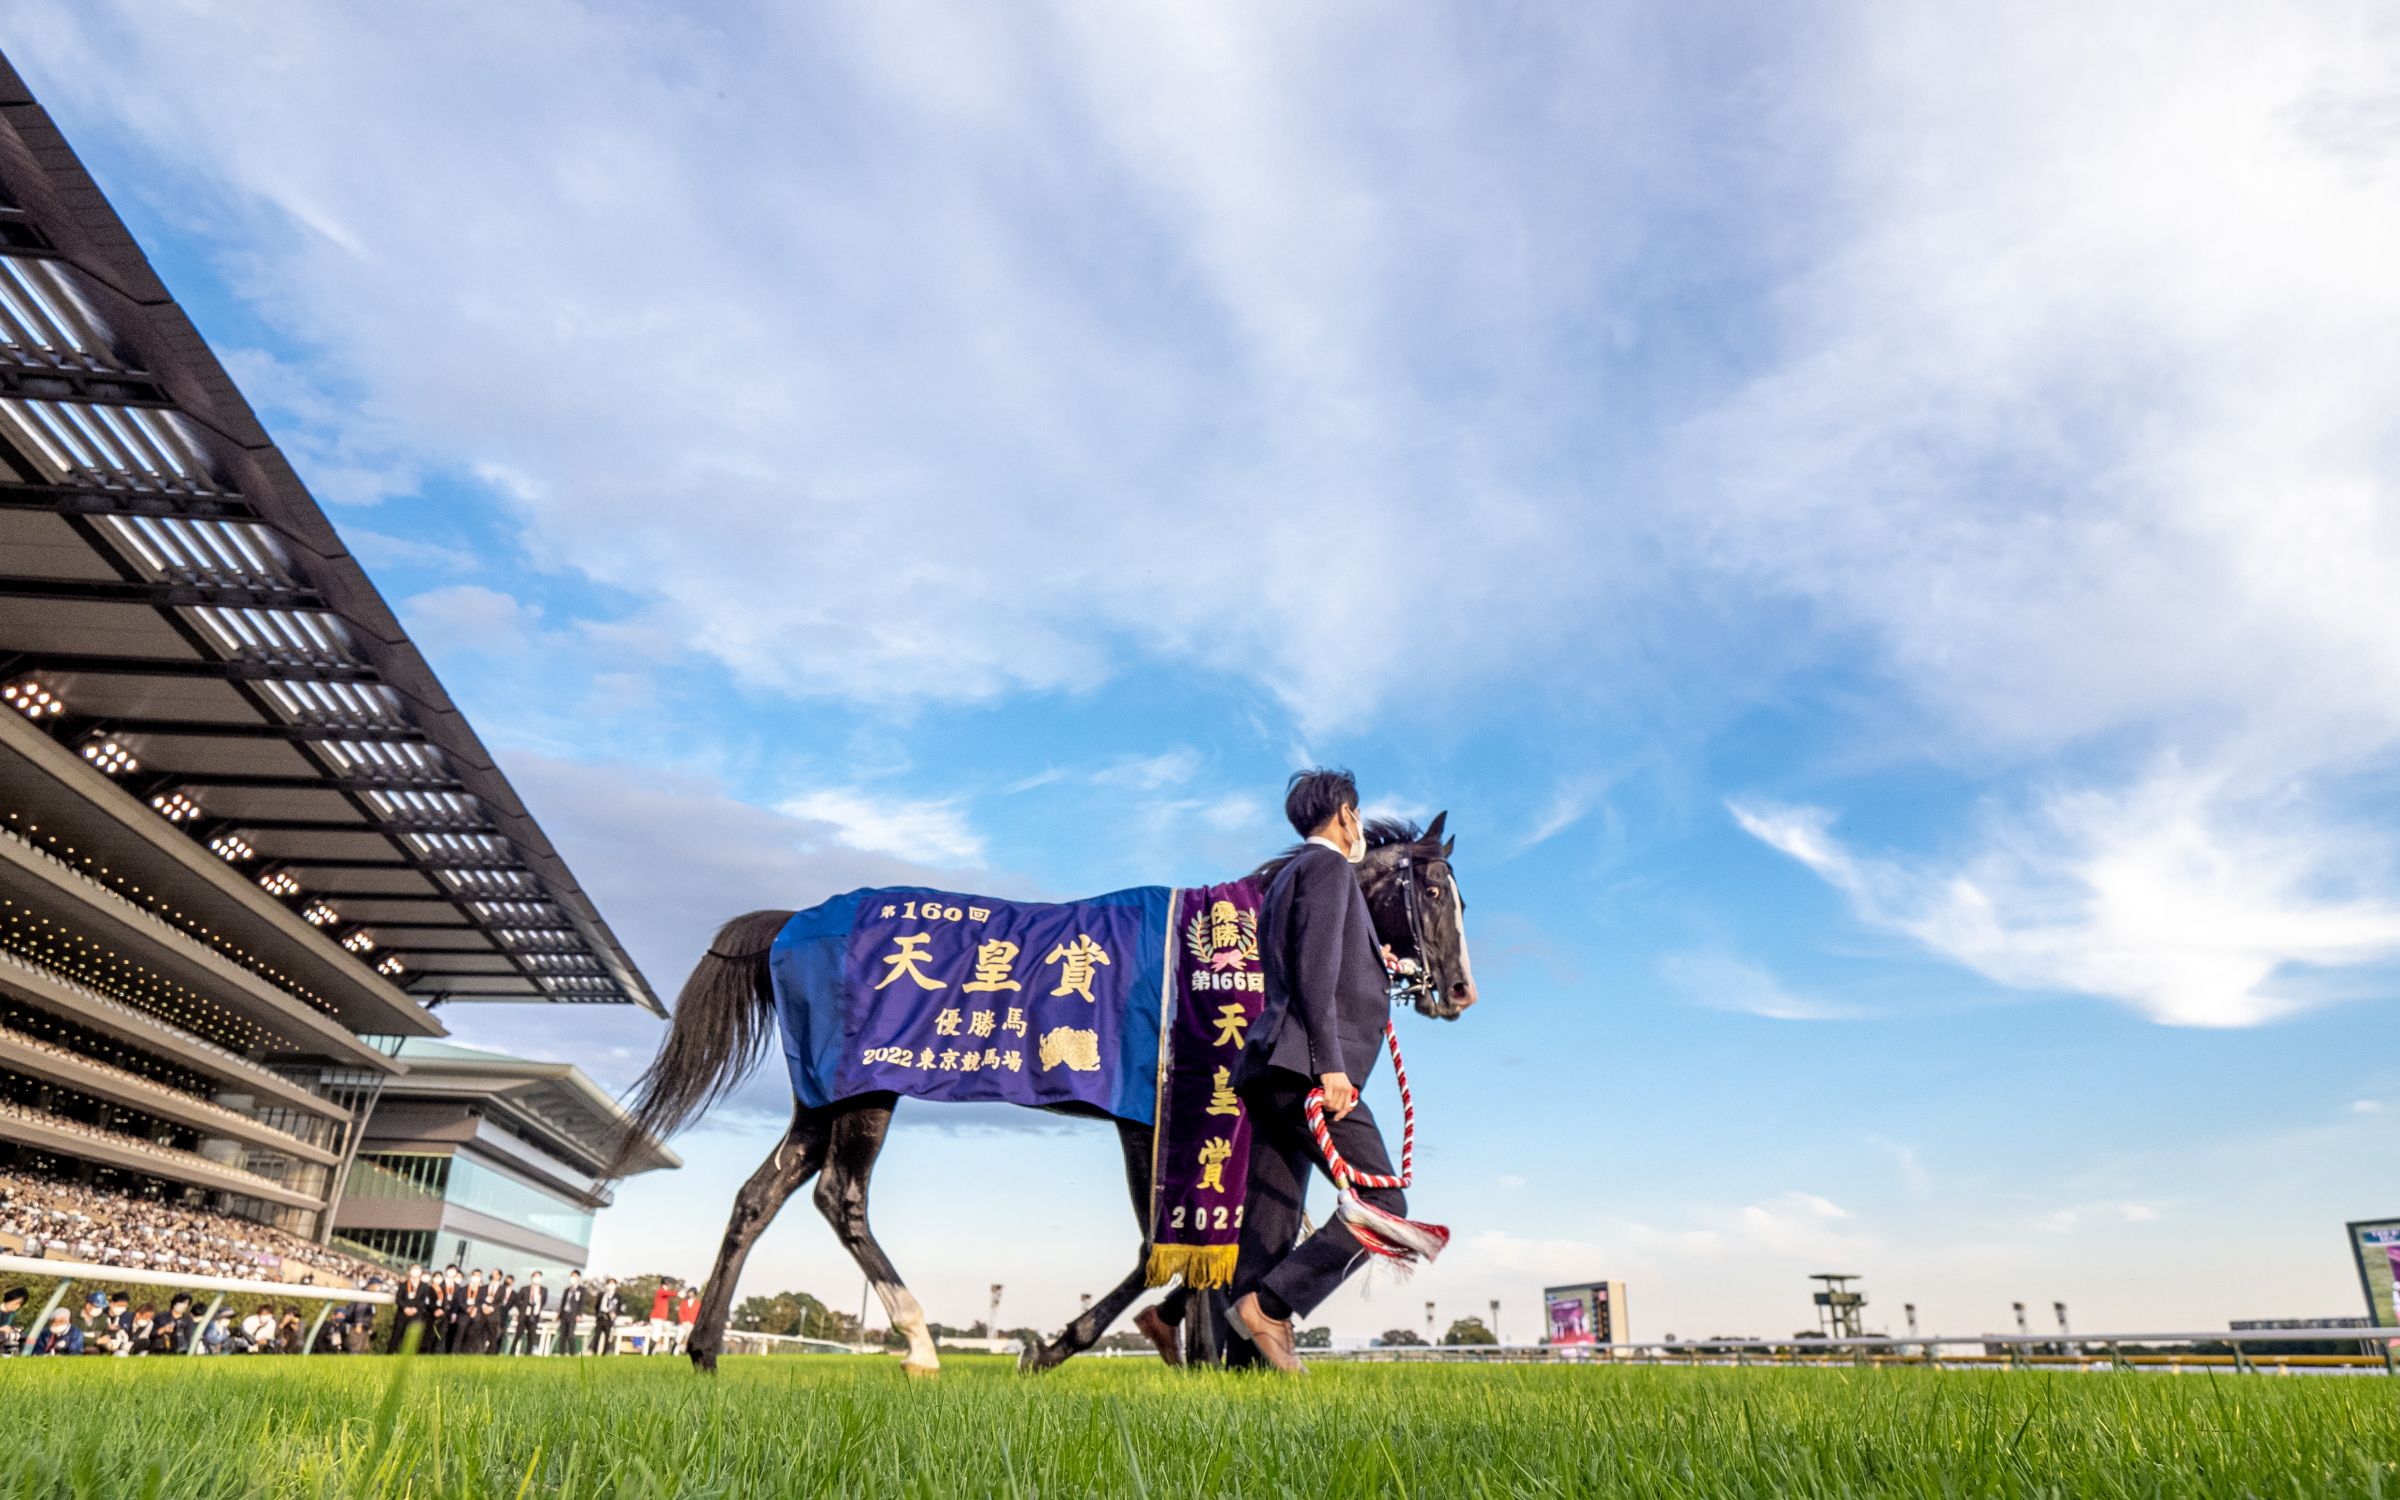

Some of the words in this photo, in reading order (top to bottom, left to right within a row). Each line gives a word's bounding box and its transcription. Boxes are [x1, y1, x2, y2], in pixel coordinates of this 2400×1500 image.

[1210, 900, 1242, 949] 優勝
[874, 932, 1111, 1003] 天皇賞
[1191, 969, 1265, 994] 第166回
[934, 1007, 1028, 1038] 優勝馬
[1196, 1003, 1248, 1194] 天皇賞
[1170, 1205, 1244, 1231] 2022
